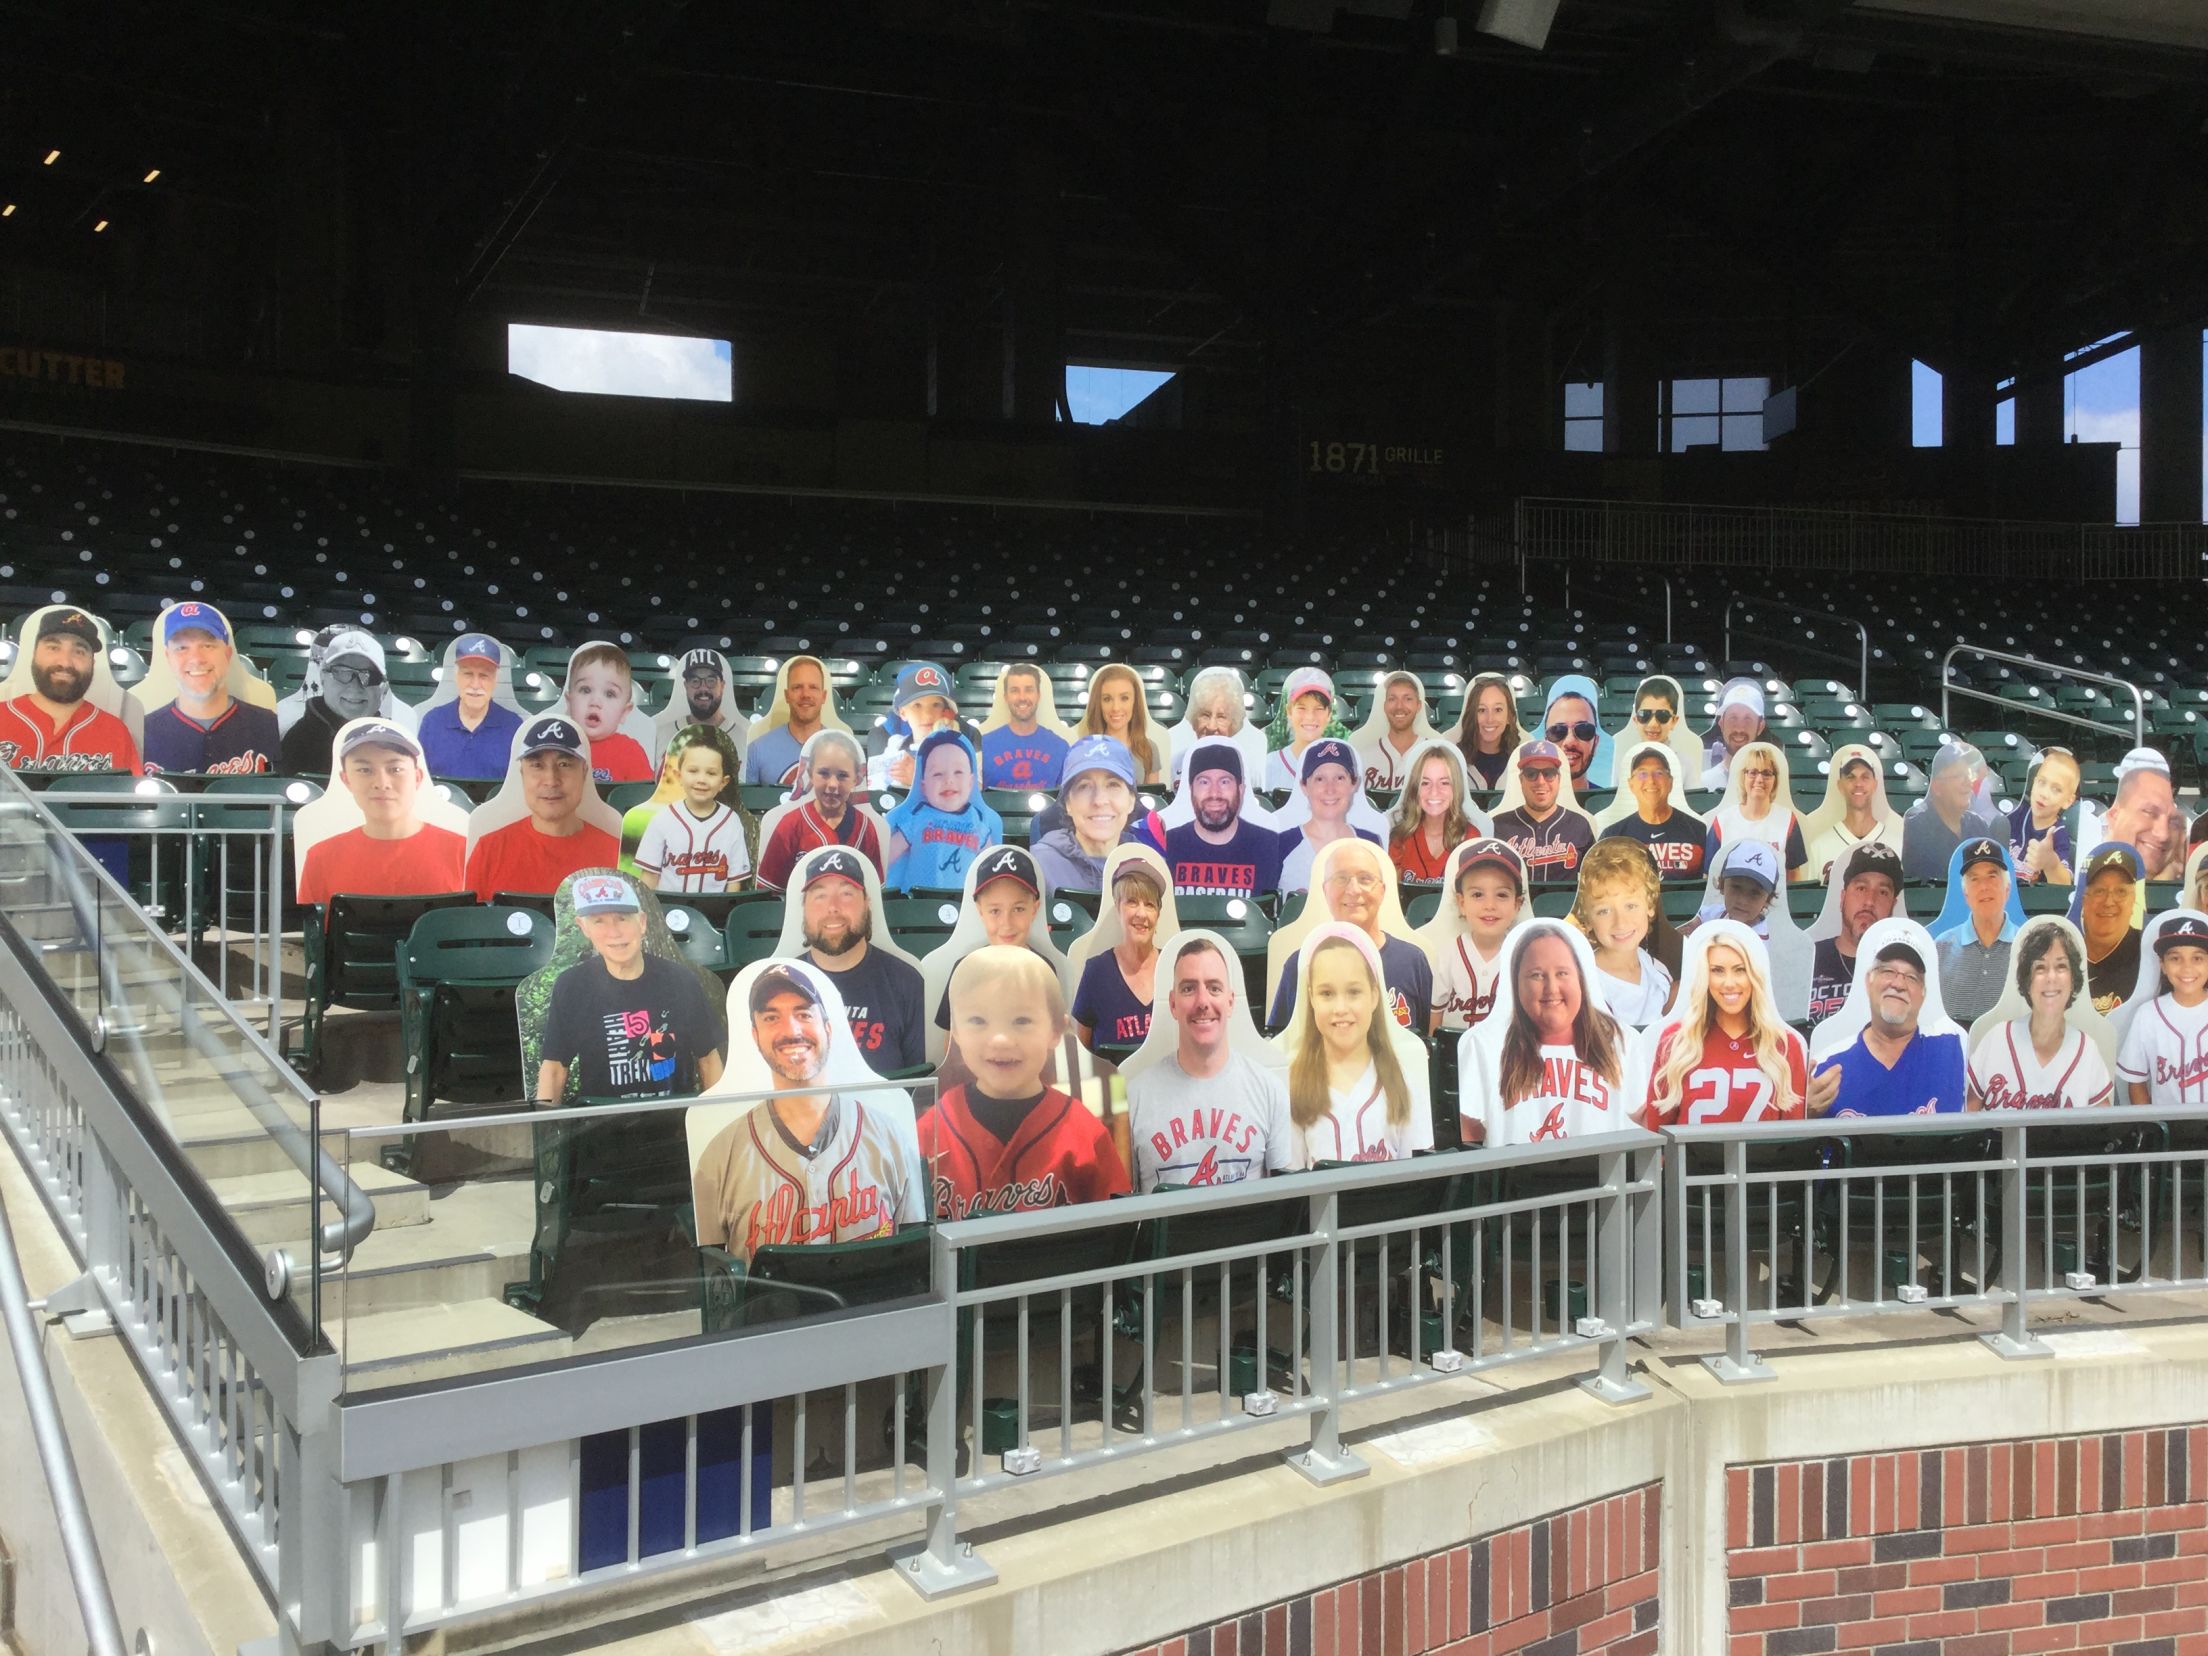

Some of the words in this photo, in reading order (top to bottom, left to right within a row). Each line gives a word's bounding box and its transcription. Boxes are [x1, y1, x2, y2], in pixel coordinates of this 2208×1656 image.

[1310, 440, 1379, 474] 1871
[1384, 446, 1444, 465] GRILLE
[689, 648, 715, 666] ATL
[538, 721, 564, 739] A
[993, 749, 1050, 766] BRAVES
[819, 852, 843, 872] A
[939, 847, 961, 873] A
[992, 851, 1018, 872] A
[1177, 865, 1253, 885] BRAVES
[626, 1013, 648, 1036] 5
[1688, 1067, 1776, 1126] 27
[1151, 1107, 1257, 1162] BRAVES
[1529, 1102, 1568, 1143] A
[1189, 1145, 1221, 1185] A
[934, 1173, 1054, 1219] Braves
[745, 1167, 878, 1257] Atlanta
